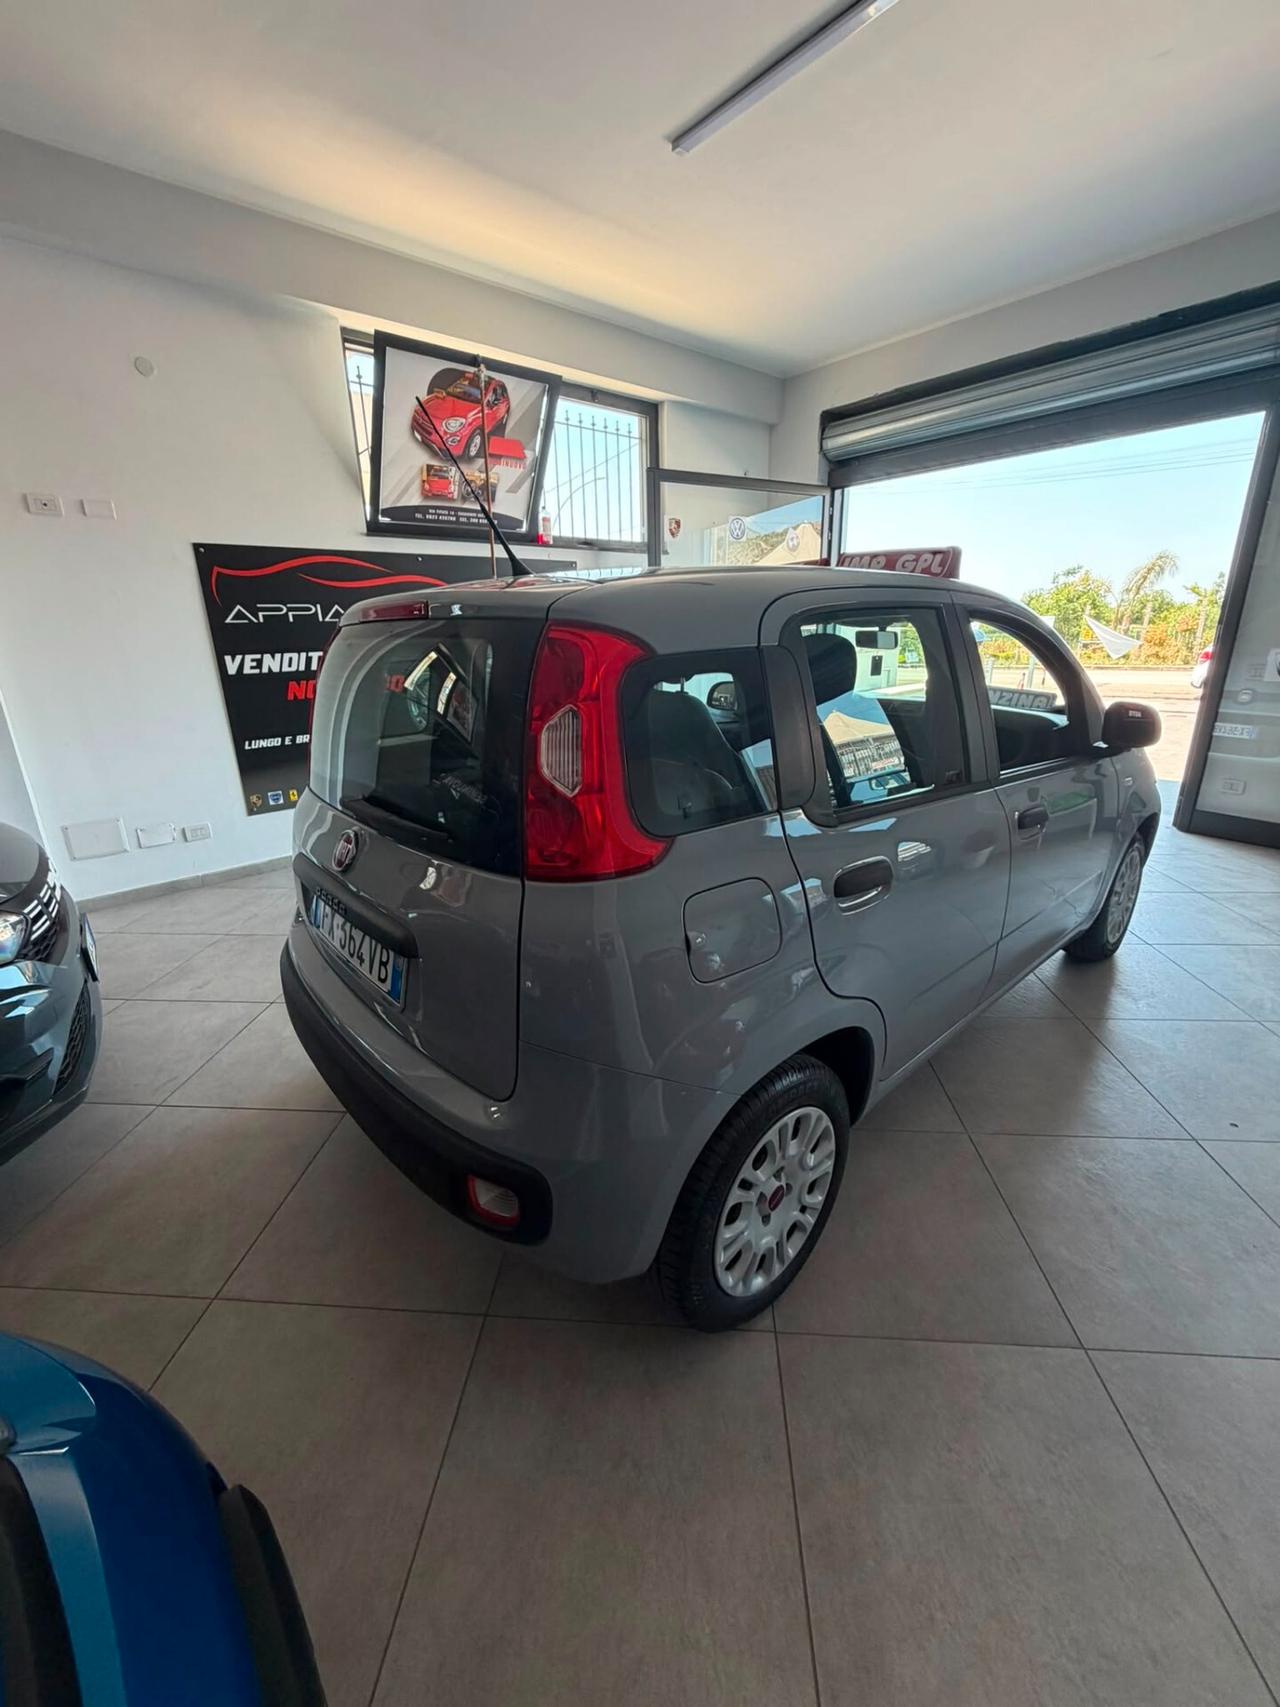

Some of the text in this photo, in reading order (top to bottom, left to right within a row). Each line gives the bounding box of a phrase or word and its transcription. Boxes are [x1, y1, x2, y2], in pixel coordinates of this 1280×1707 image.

[895, 552, 944, 574] GPL
[225, 604, 344, 623] APPIA
[244, 737, 282, 750] LUNGO
[284, 736, 292, 745] E
